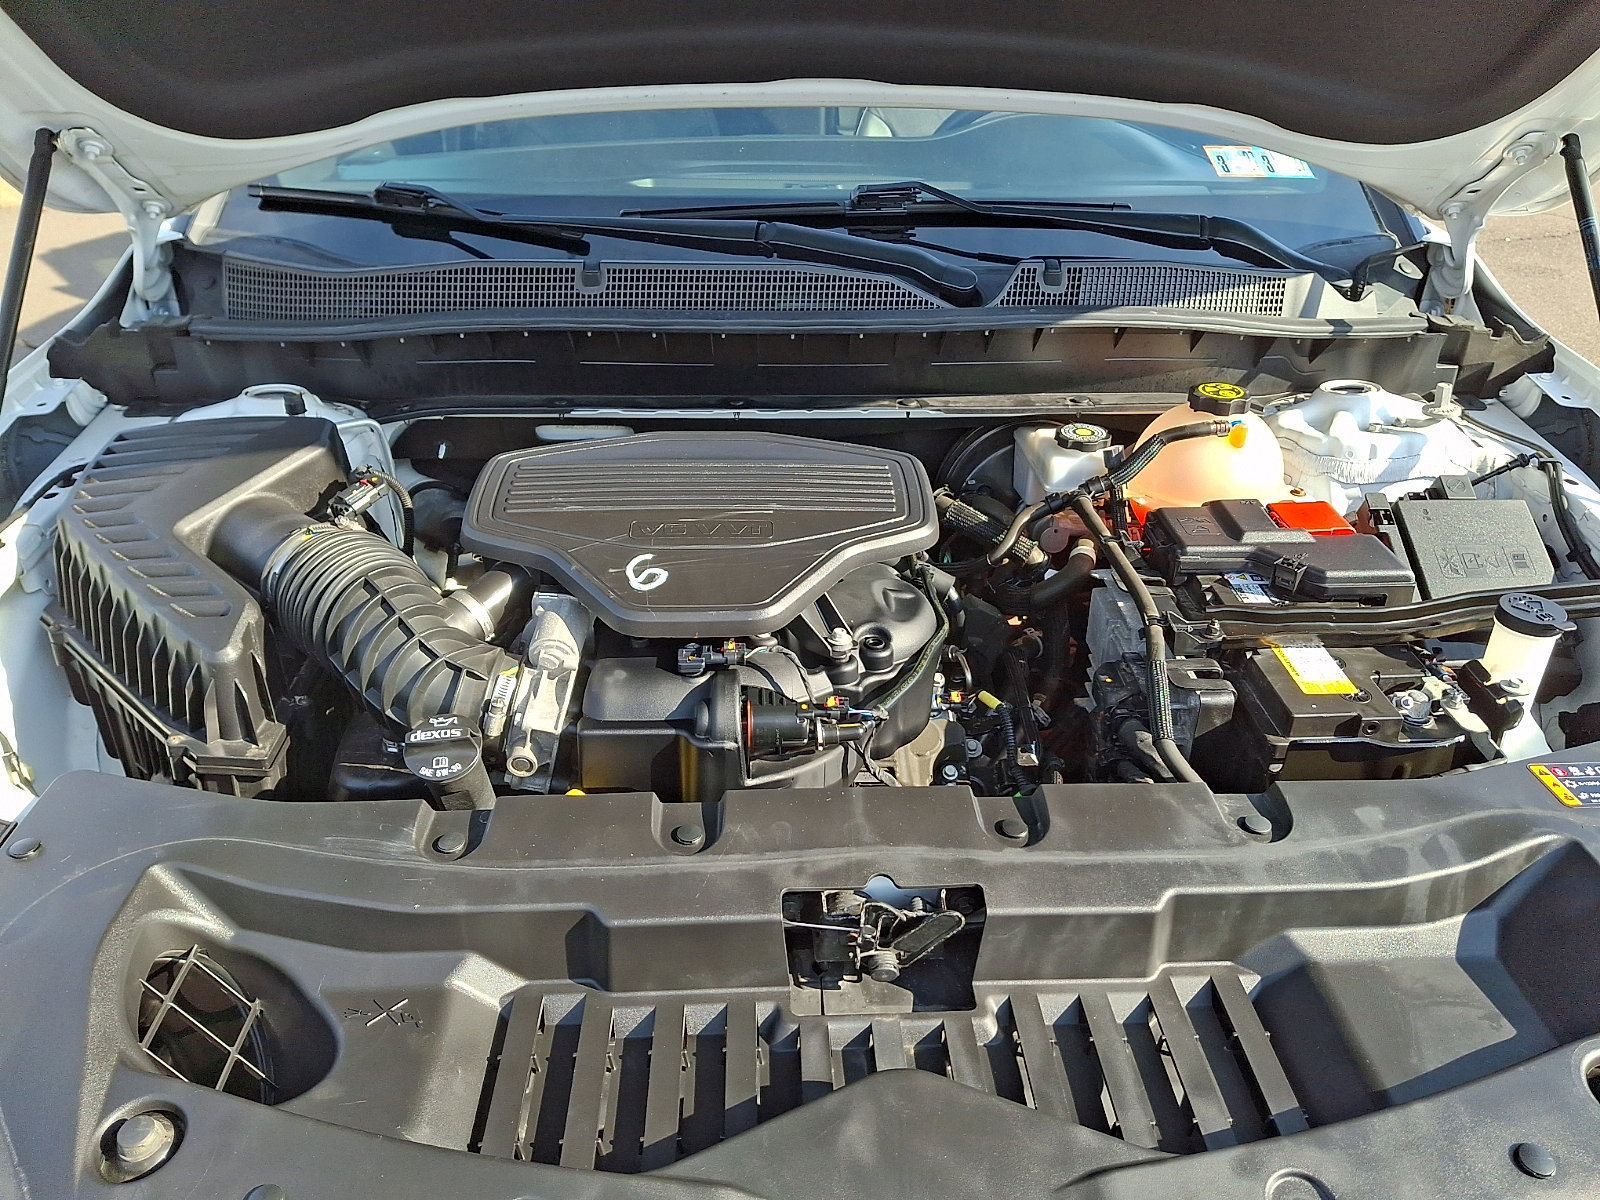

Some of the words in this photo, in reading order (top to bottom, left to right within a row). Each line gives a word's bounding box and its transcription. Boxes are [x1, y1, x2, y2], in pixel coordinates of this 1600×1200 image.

[1216, 155, 1230, 173] 3
[1261, 155, 1275, 173] 3
[625, 553, 669, 591] 6
[410, 728, 462, 742] dexos
[419, 767, 434, 778] SAE
[435, 763, 462, 778] 5W-30
